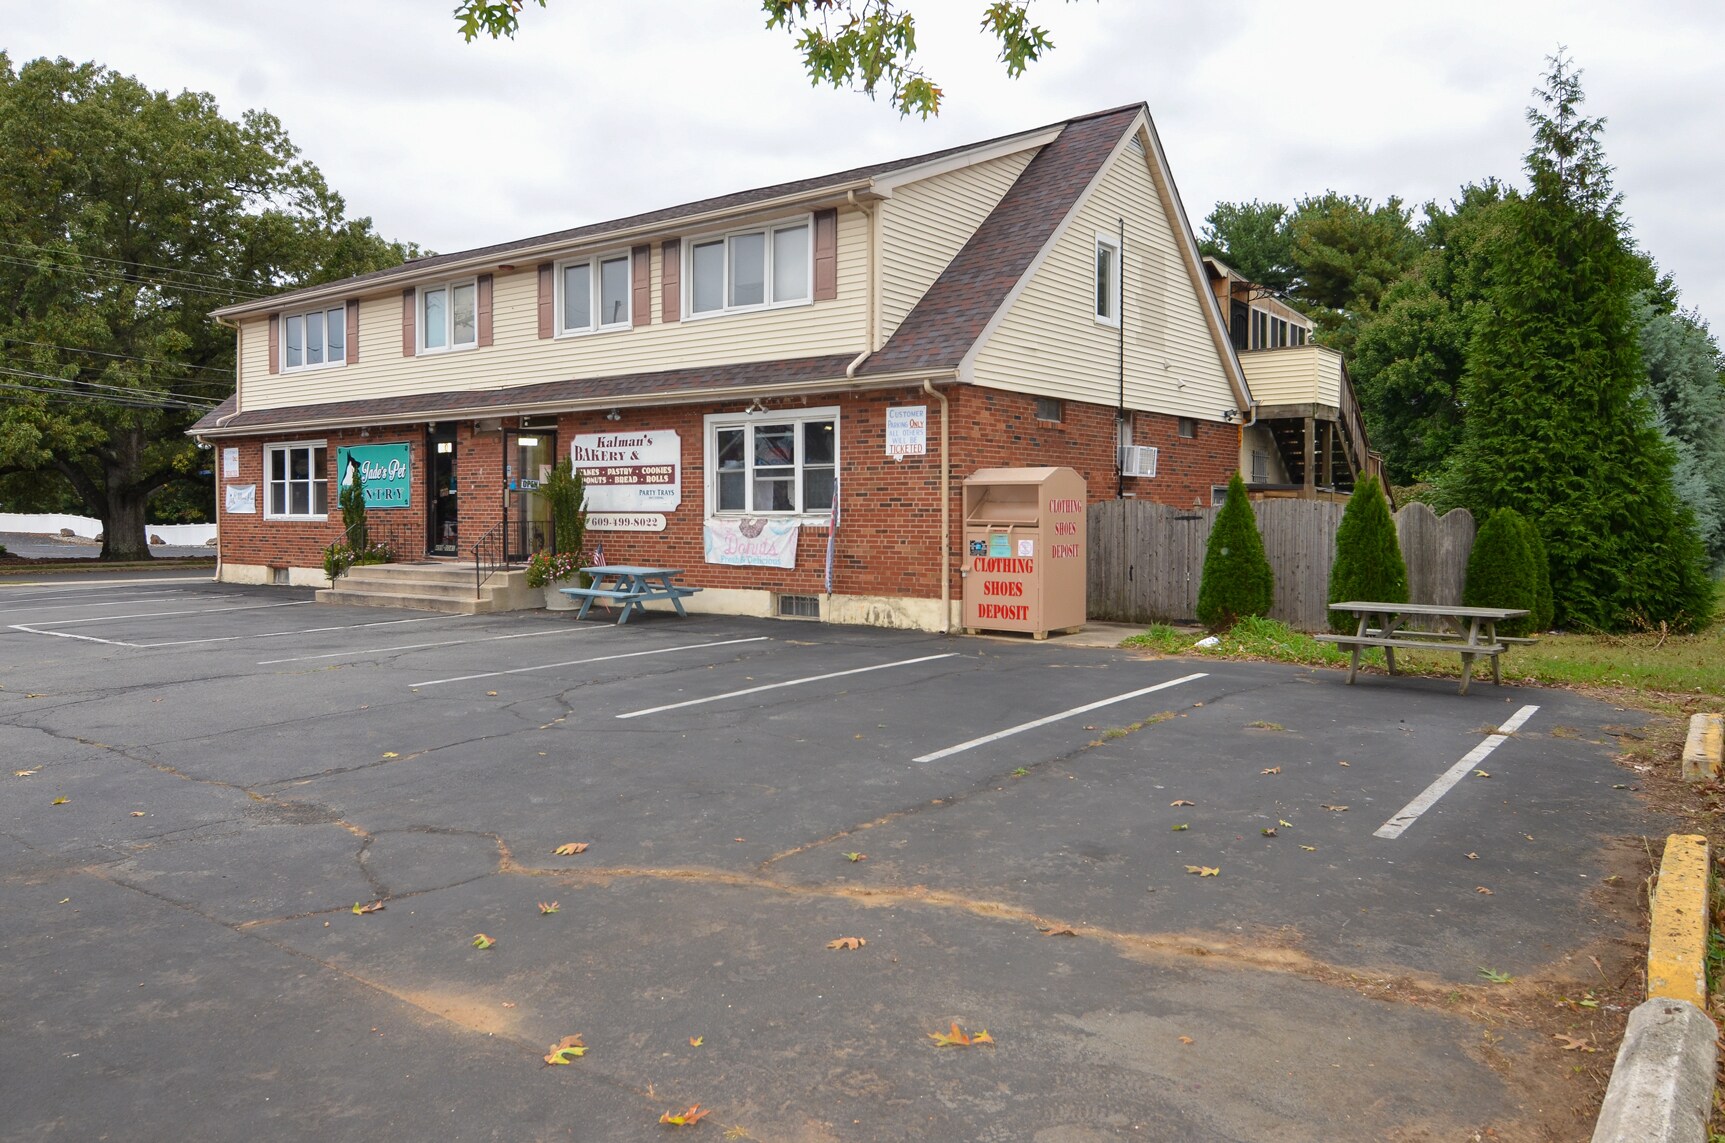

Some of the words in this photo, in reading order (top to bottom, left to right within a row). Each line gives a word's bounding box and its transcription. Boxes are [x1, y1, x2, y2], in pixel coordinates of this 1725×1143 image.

[597, 434, 653, 448] Kalman's
[574, 445, 626, 461] BAKERY
[630, 450, 640, 461] &
[890, 444, 922, 454] TICKETED
[361, 460, 388, 484] Jade's
[388, 458, 406, 482] Pet
[607, 467, 633, 476] PASTRY
[641, 466, 673, 474] COOKIES
[614, 475, 638, 484] BREAD
[646, 475, 669, 483] ROLLS
[1049, 499, 1082, 513] CLOTHING
[591, 517, 658, 527] 609-499-8022
[1055, 522, 1076, 535] SHOES
[1052, 544, 1079, 558] DEPOSIT
[973, 557, 1034, 573] CLOTHING
[983, 581, 1023, 597] SHOES
[978, 603, 1030, 621] DEPOSIT
